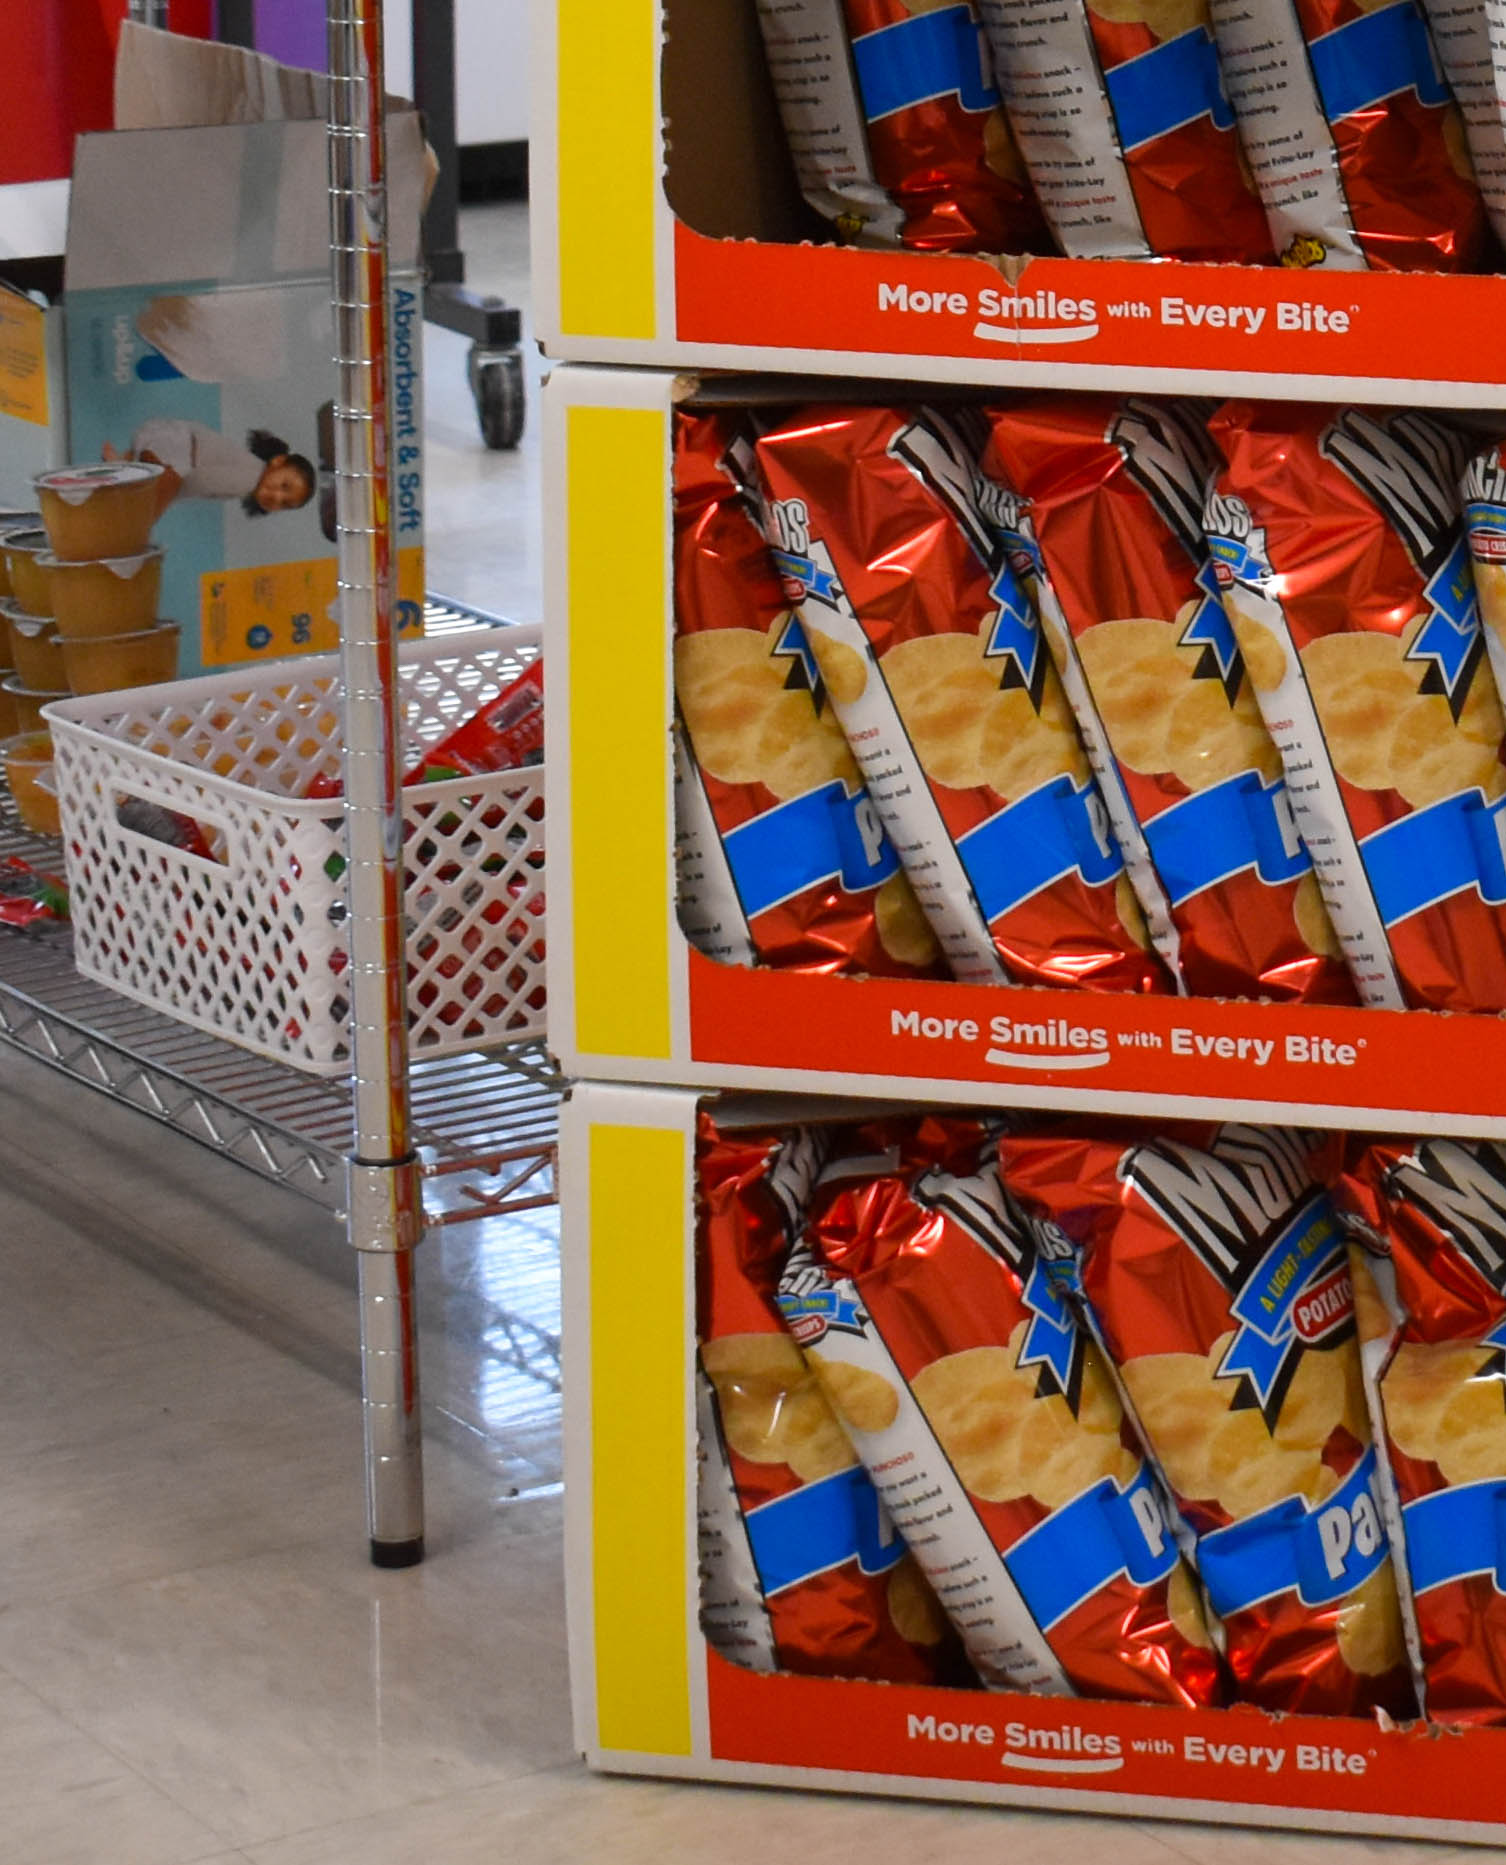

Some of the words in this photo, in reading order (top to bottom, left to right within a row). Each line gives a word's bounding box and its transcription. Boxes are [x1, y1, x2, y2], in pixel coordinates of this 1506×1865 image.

[879, 285, 968, 314] More
[978, 288, 1097, 321] Smiles
[1106, 301, 1151, 320] with
[1161, 297, 1265, 334] Every
[393, 288, 420, 437] Absorbent
[400, 446, 419, 466] &
[399, 473, 422, 533] Soft
[292, 613, 310, 644] 96
[891, 1010, 979, 1043] More
[990, 1017, 1108, 1050] Smiles
[1116, 1030, 1162, 1050] with
[1172, 1027, 1275, 1064] Every
[1259, 1294, 1275, 1314] A
[907, 1713, 995, 1747] More
[1004, 1722, 1122, 1756] Smiles
[1131, 1736, 1175, 1756] with
[1183, 1736, 1285, 1773] Every
